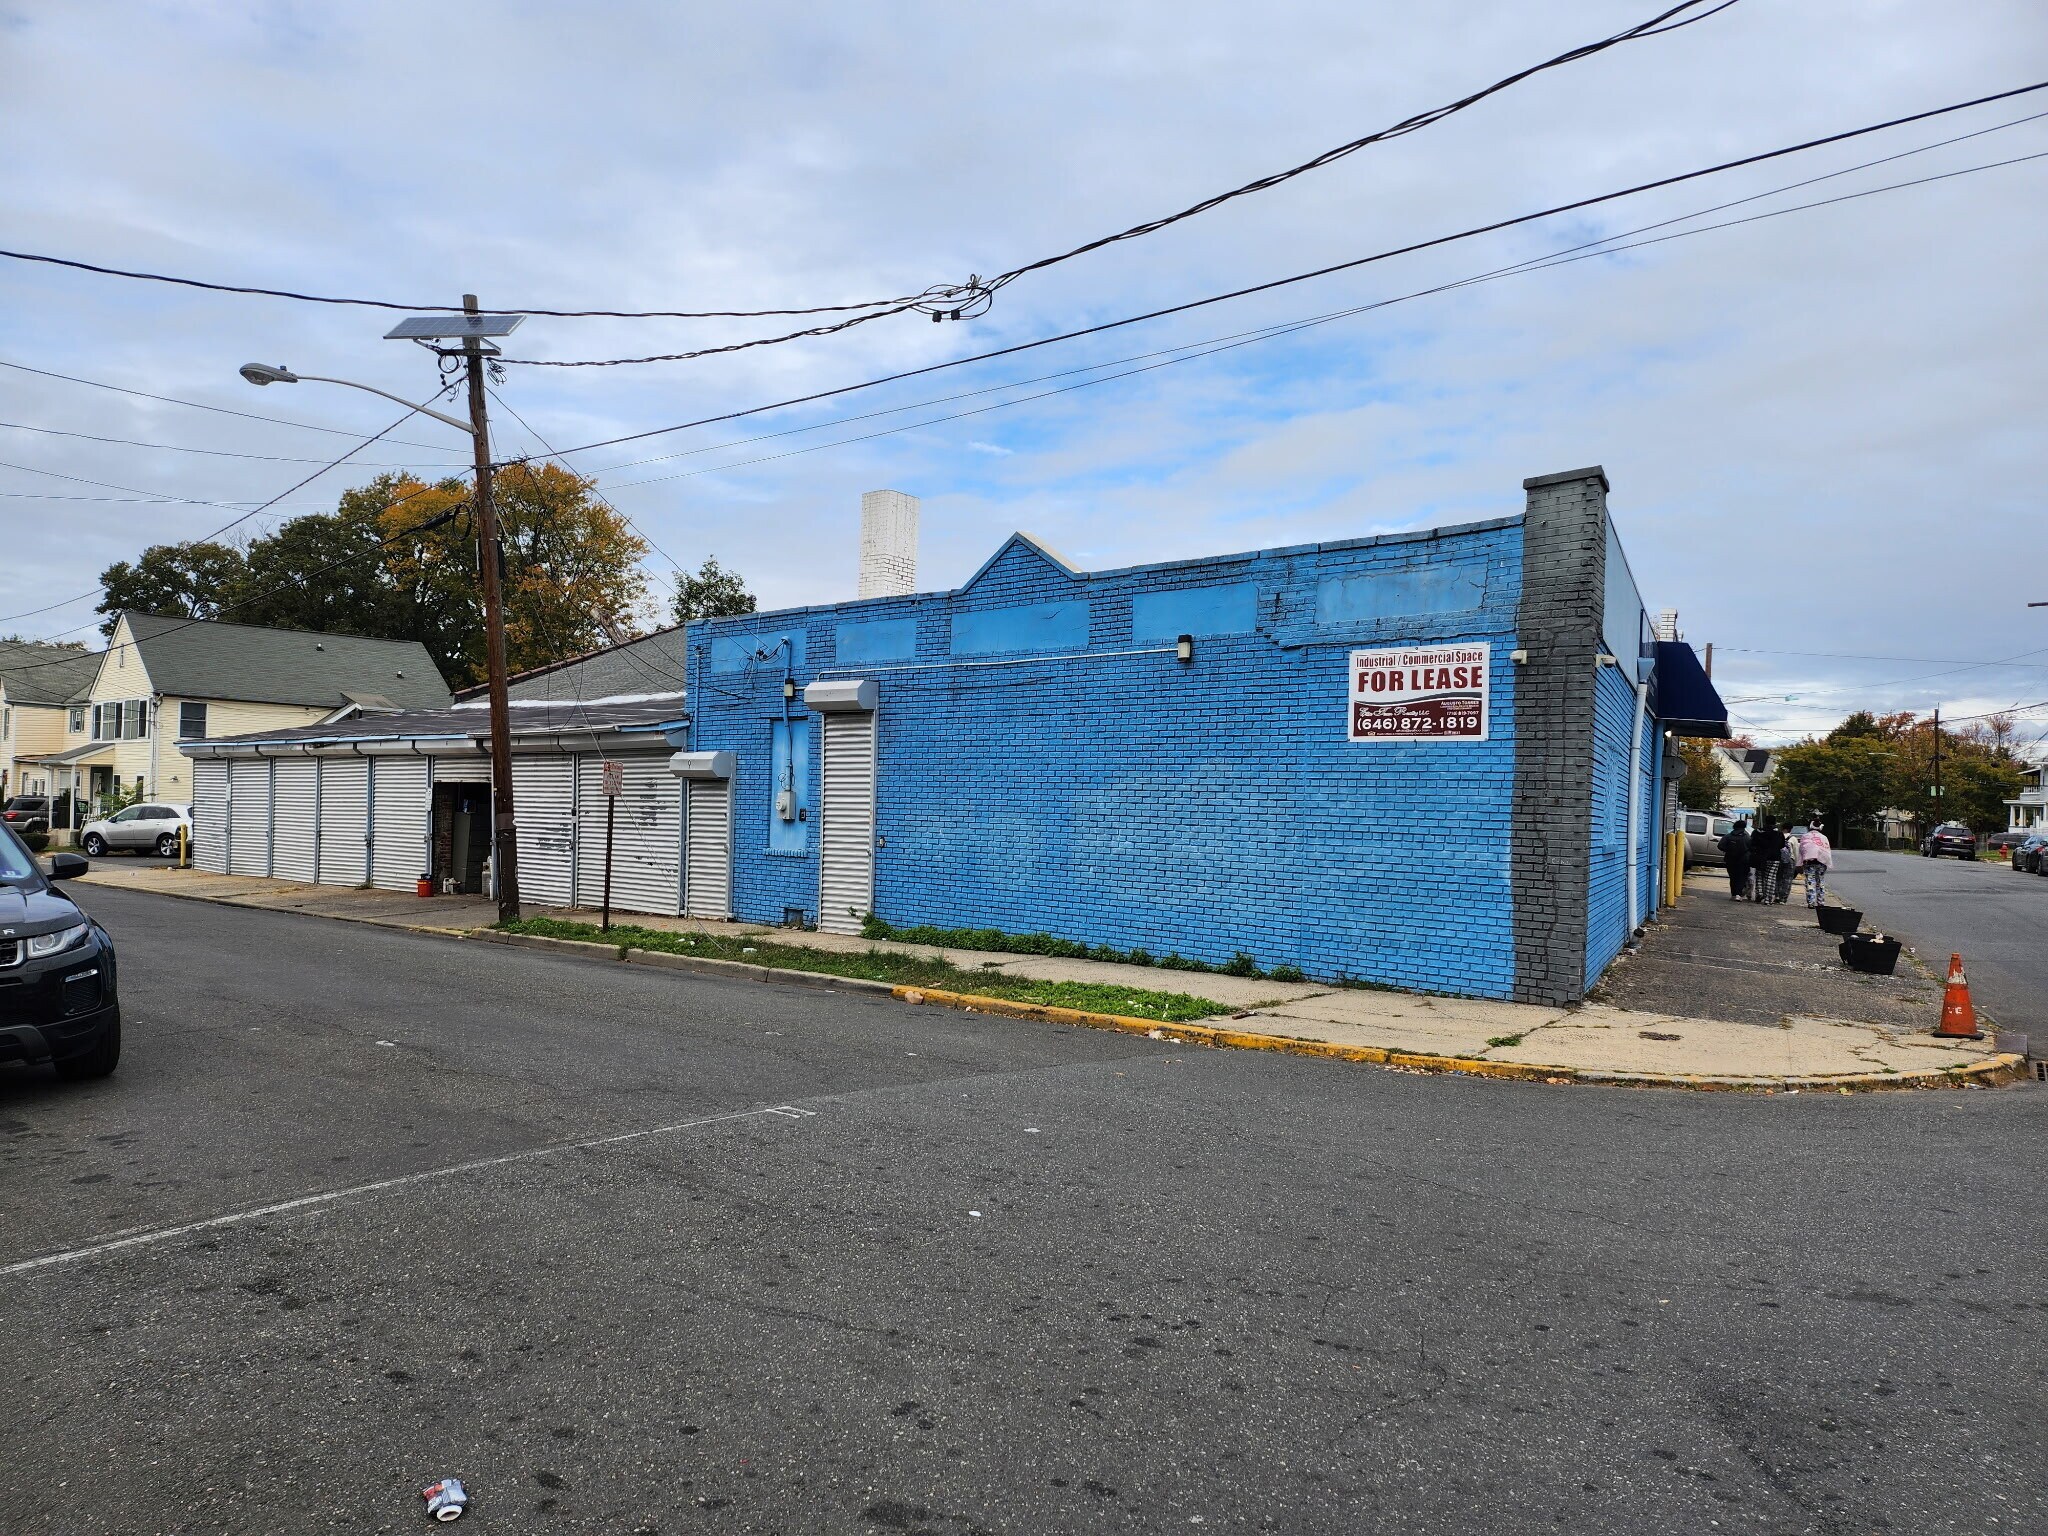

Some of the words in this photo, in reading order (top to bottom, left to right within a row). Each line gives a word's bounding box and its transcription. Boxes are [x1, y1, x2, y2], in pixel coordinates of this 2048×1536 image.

[1356, 655, 1396, 668] Industrial
[1403, 652, 1455, 666] Commercial
[1455, 651, 1483, 664] Space
[1358, 671, 1404, 692] FOR
[1411, 666, 1483, 690] LEASE
[1357, 718, 1398, 731] (646)
[1400, 716, 1478, 730] 872-1819
